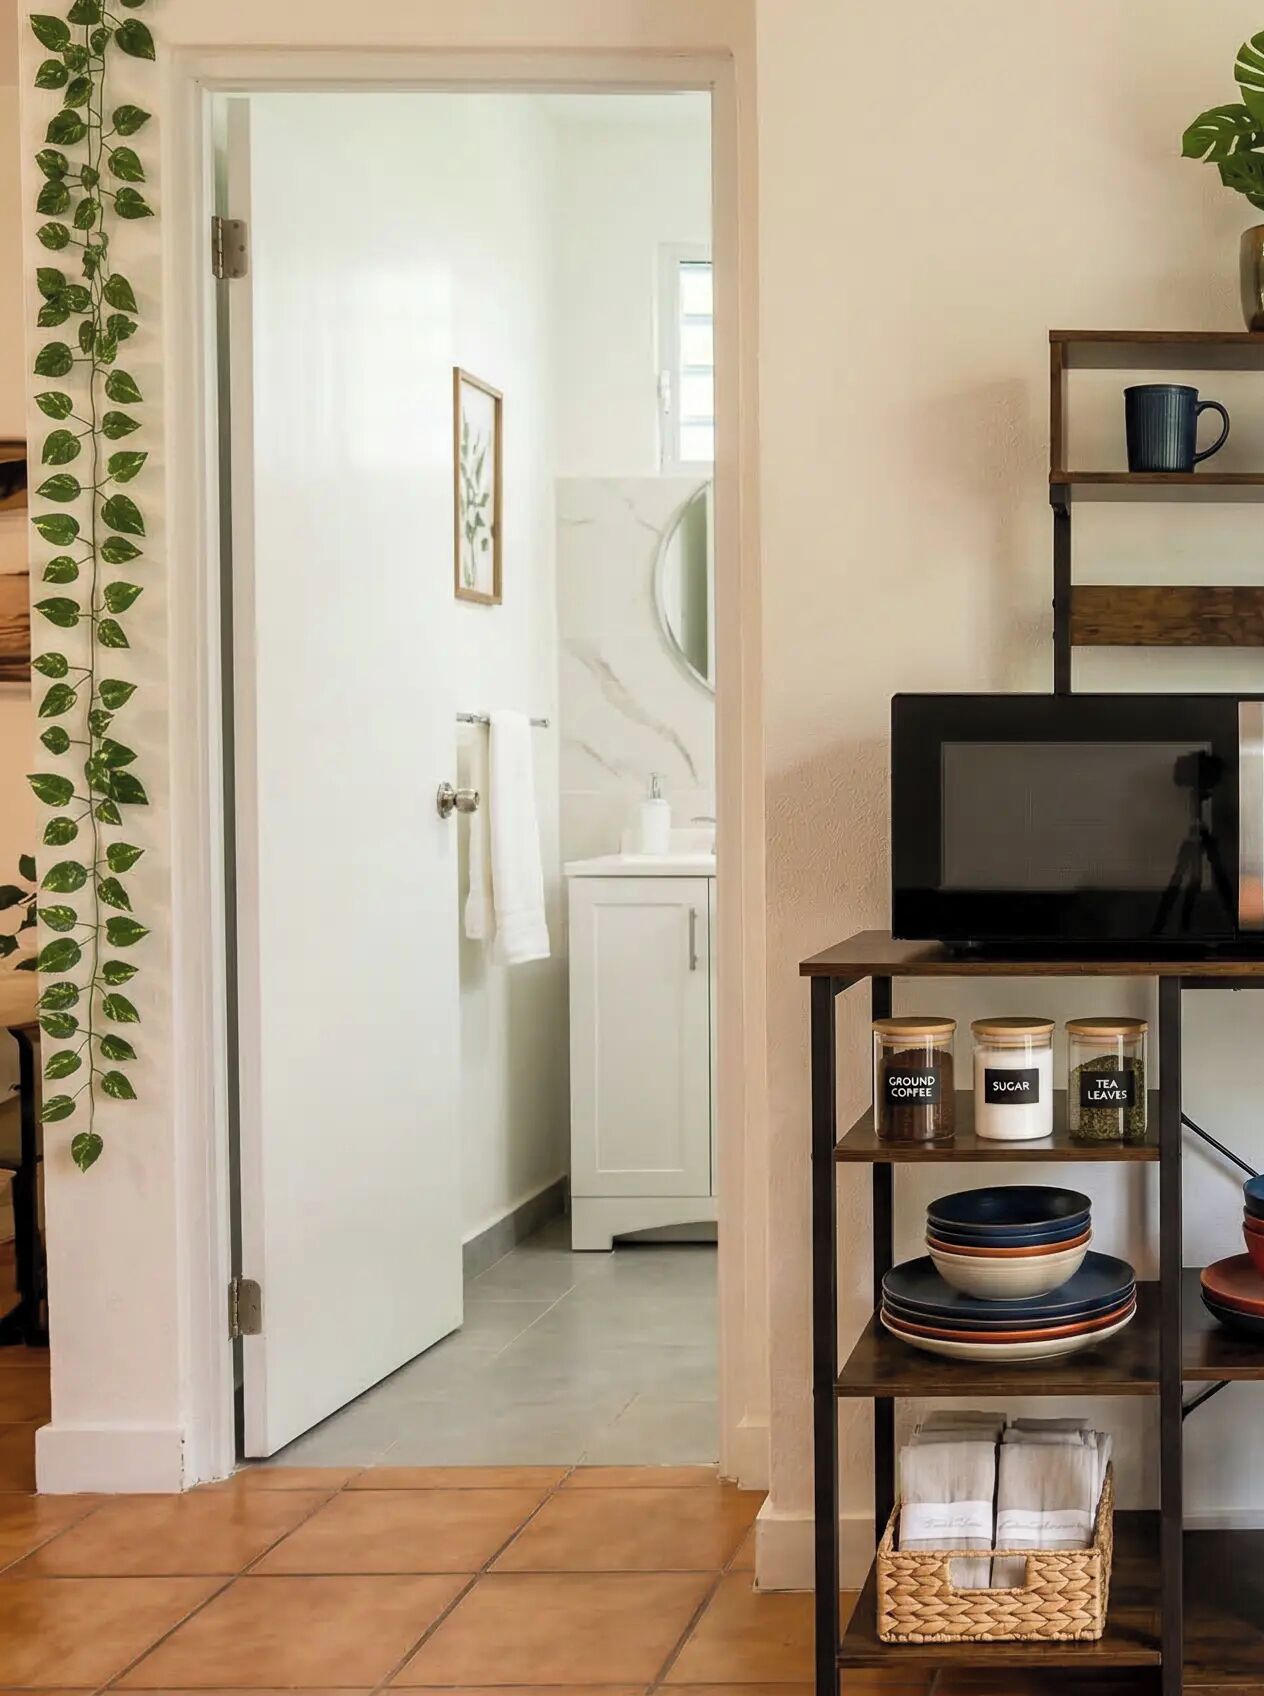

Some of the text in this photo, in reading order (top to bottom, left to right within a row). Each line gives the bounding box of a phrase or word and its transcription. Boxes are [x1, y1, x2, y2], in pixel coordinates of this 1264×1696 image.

[888, 1076, 936, 1086] GROUND
[992, 1081, 1030, 1091] SUGAR
[1095, 1079, 1119, 1089] TEA
[1087, 1090, 1128, 1100] LEAVES
